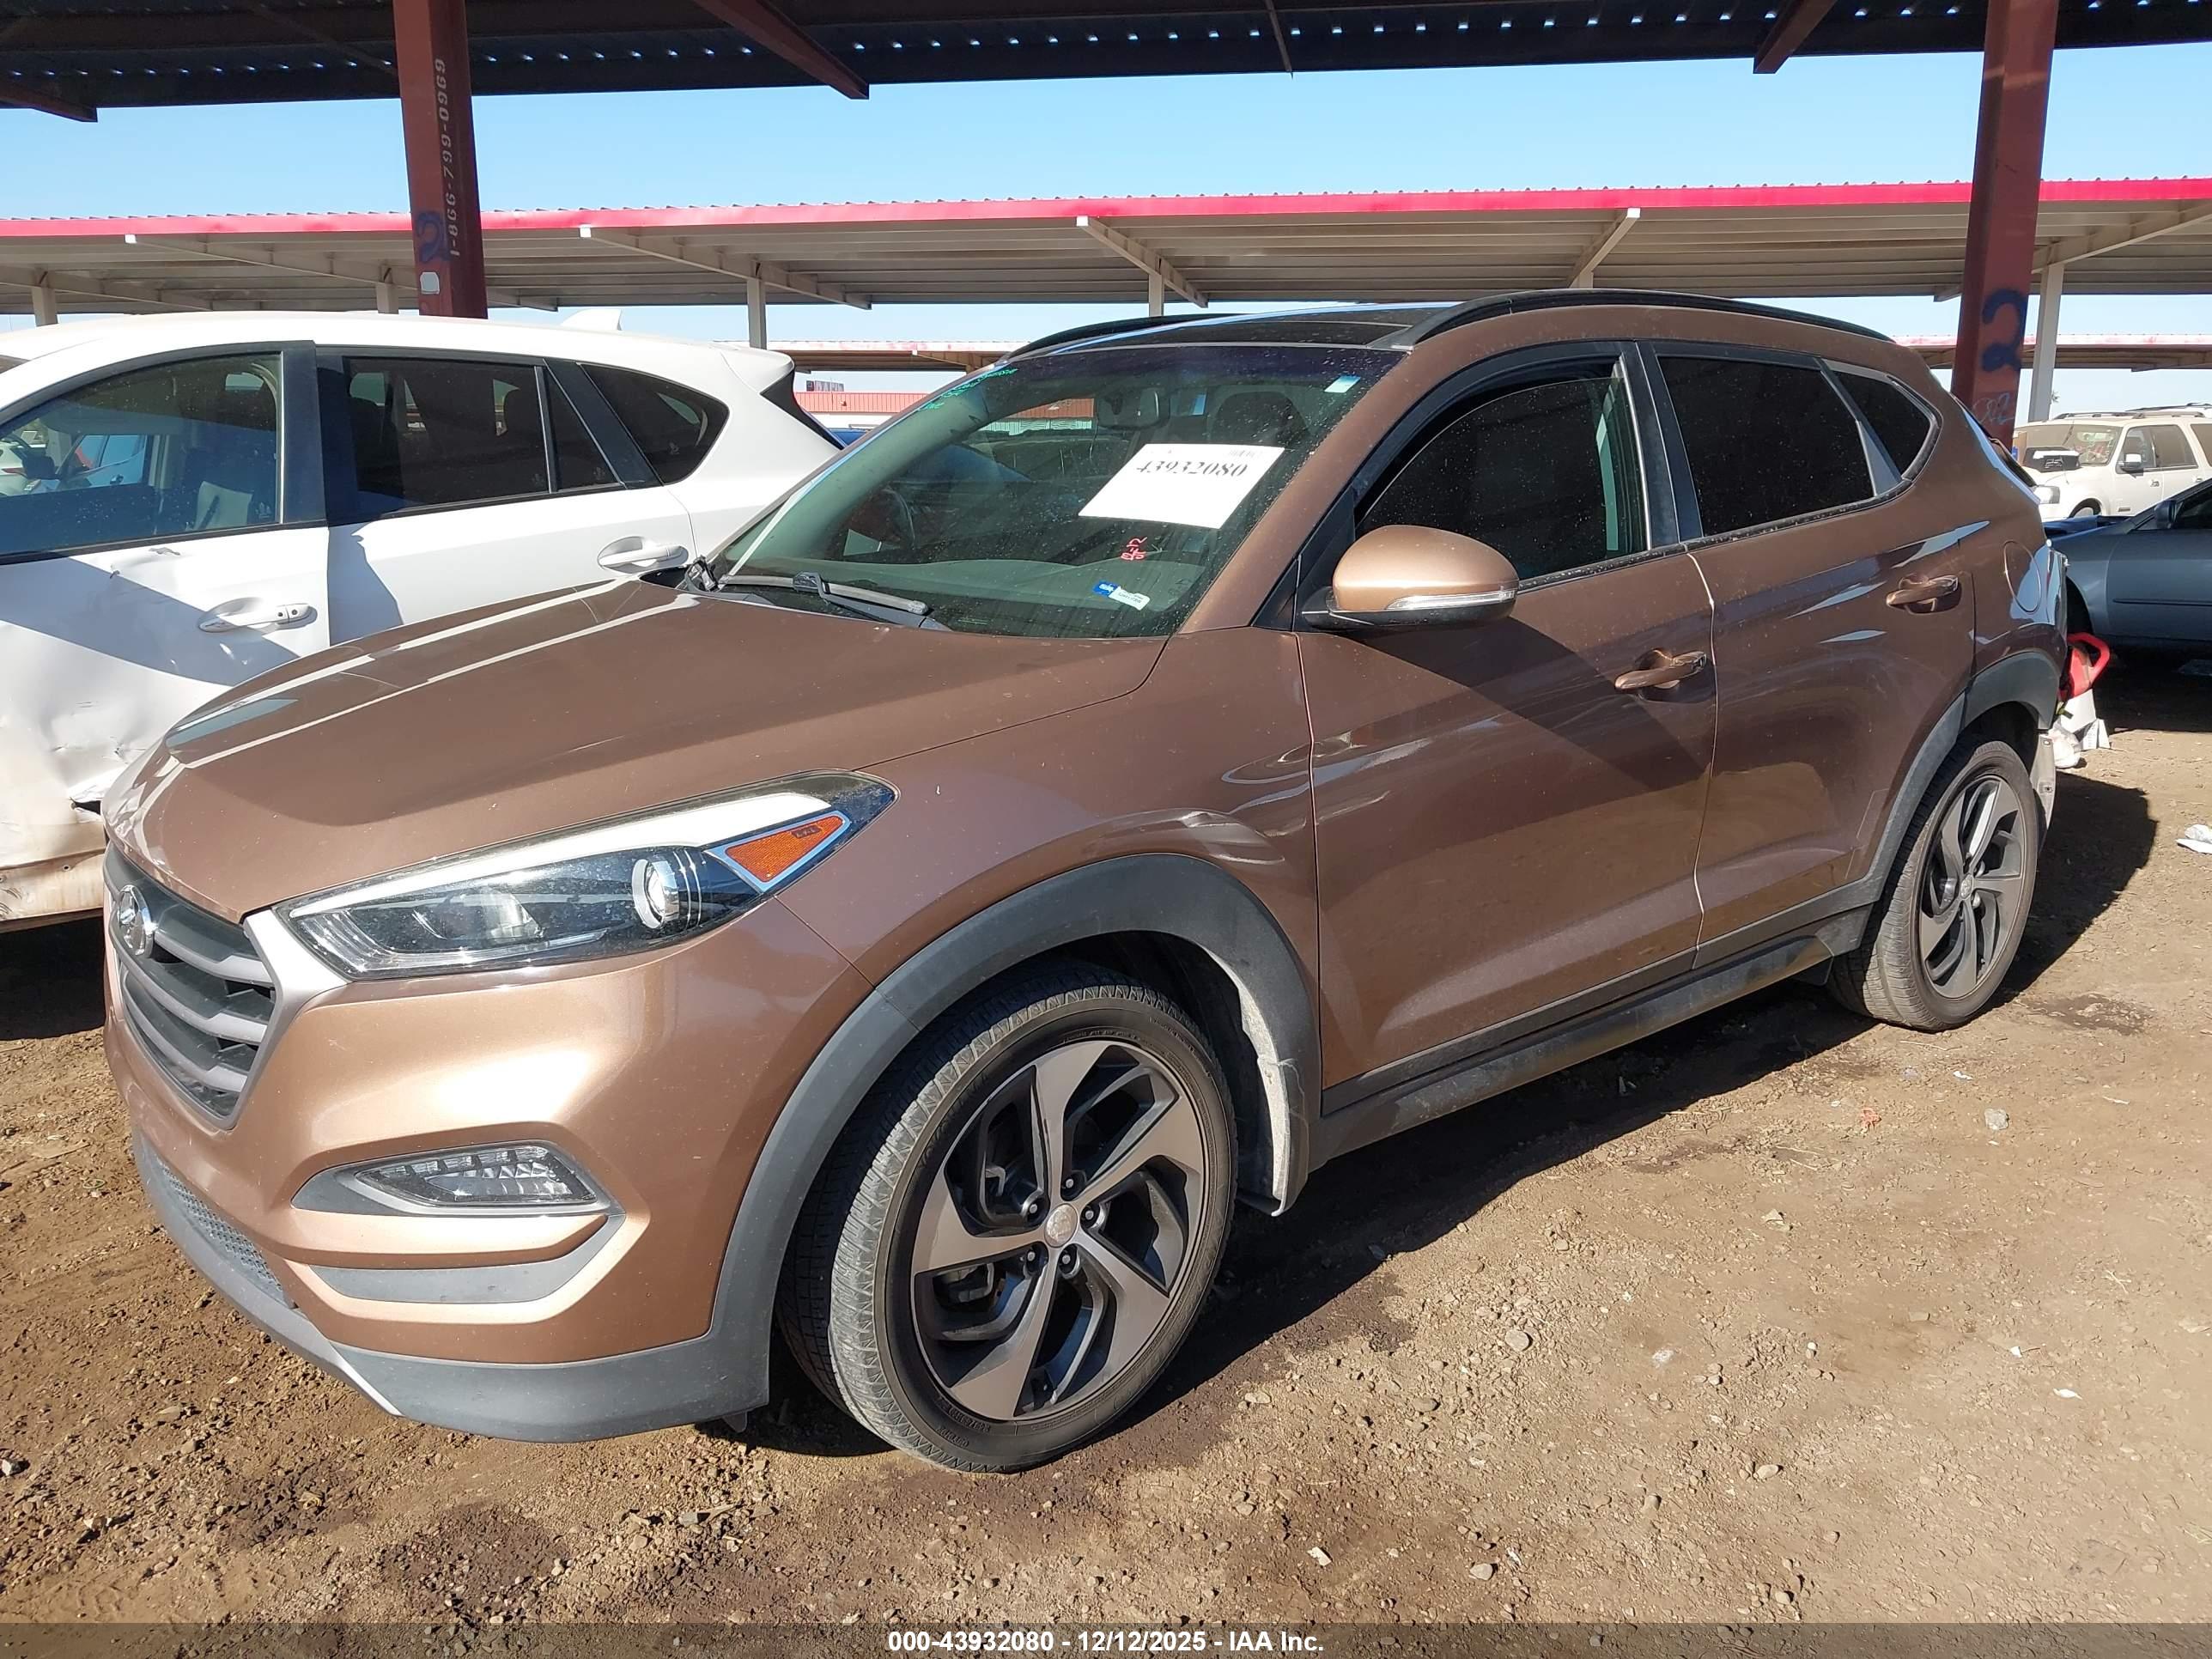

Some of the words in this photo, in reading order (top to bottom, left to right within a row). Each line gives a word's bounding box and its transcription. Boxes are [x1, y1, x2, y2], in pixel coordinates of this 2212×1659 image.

[434, 58, 460, 257] 1-866-799-0969
[1982, 288, 2025, 373] 2
[1136, 460, 1249, 477] 43932080
